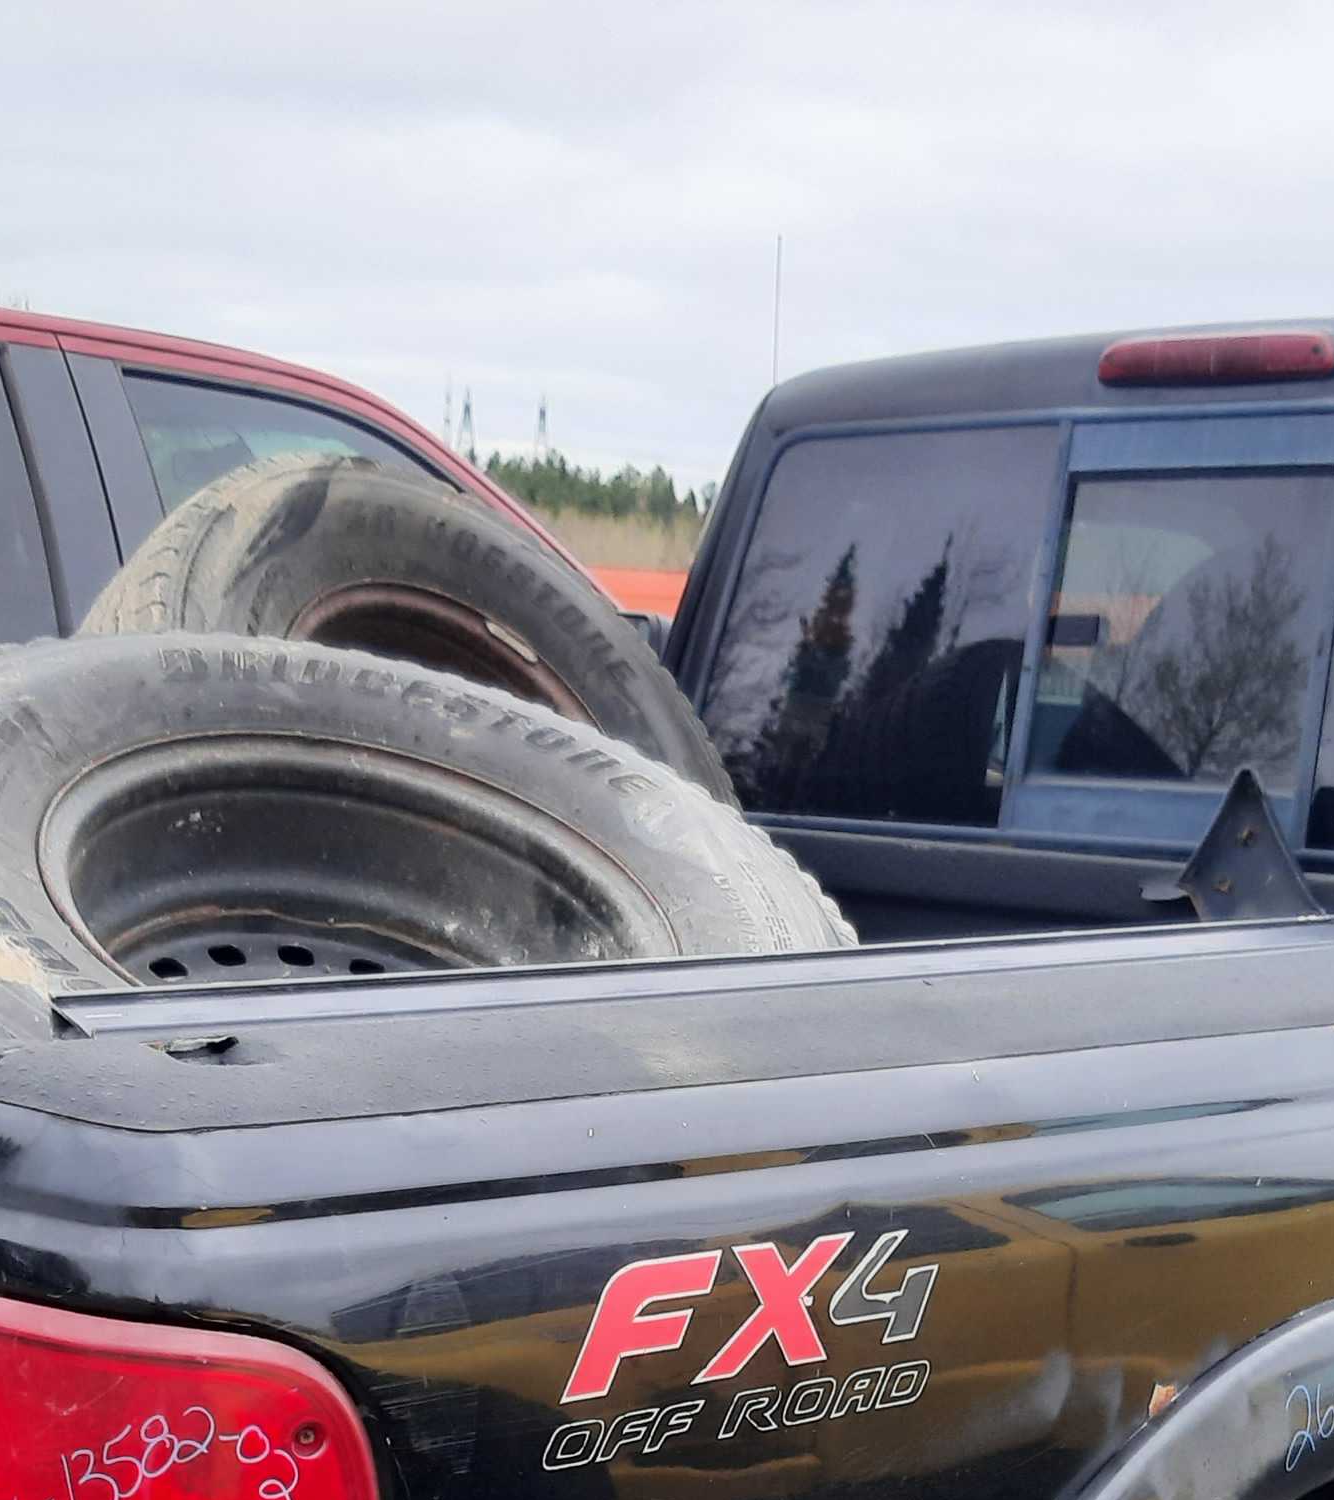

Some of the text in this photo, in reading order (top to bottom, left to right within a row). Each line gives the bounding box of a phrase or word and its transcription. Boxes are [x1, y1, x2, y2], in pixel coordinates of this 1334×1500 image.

[559, 1228, 939, 1404] FX4
[542, 1360, 931, 1471] OFF ROAD
